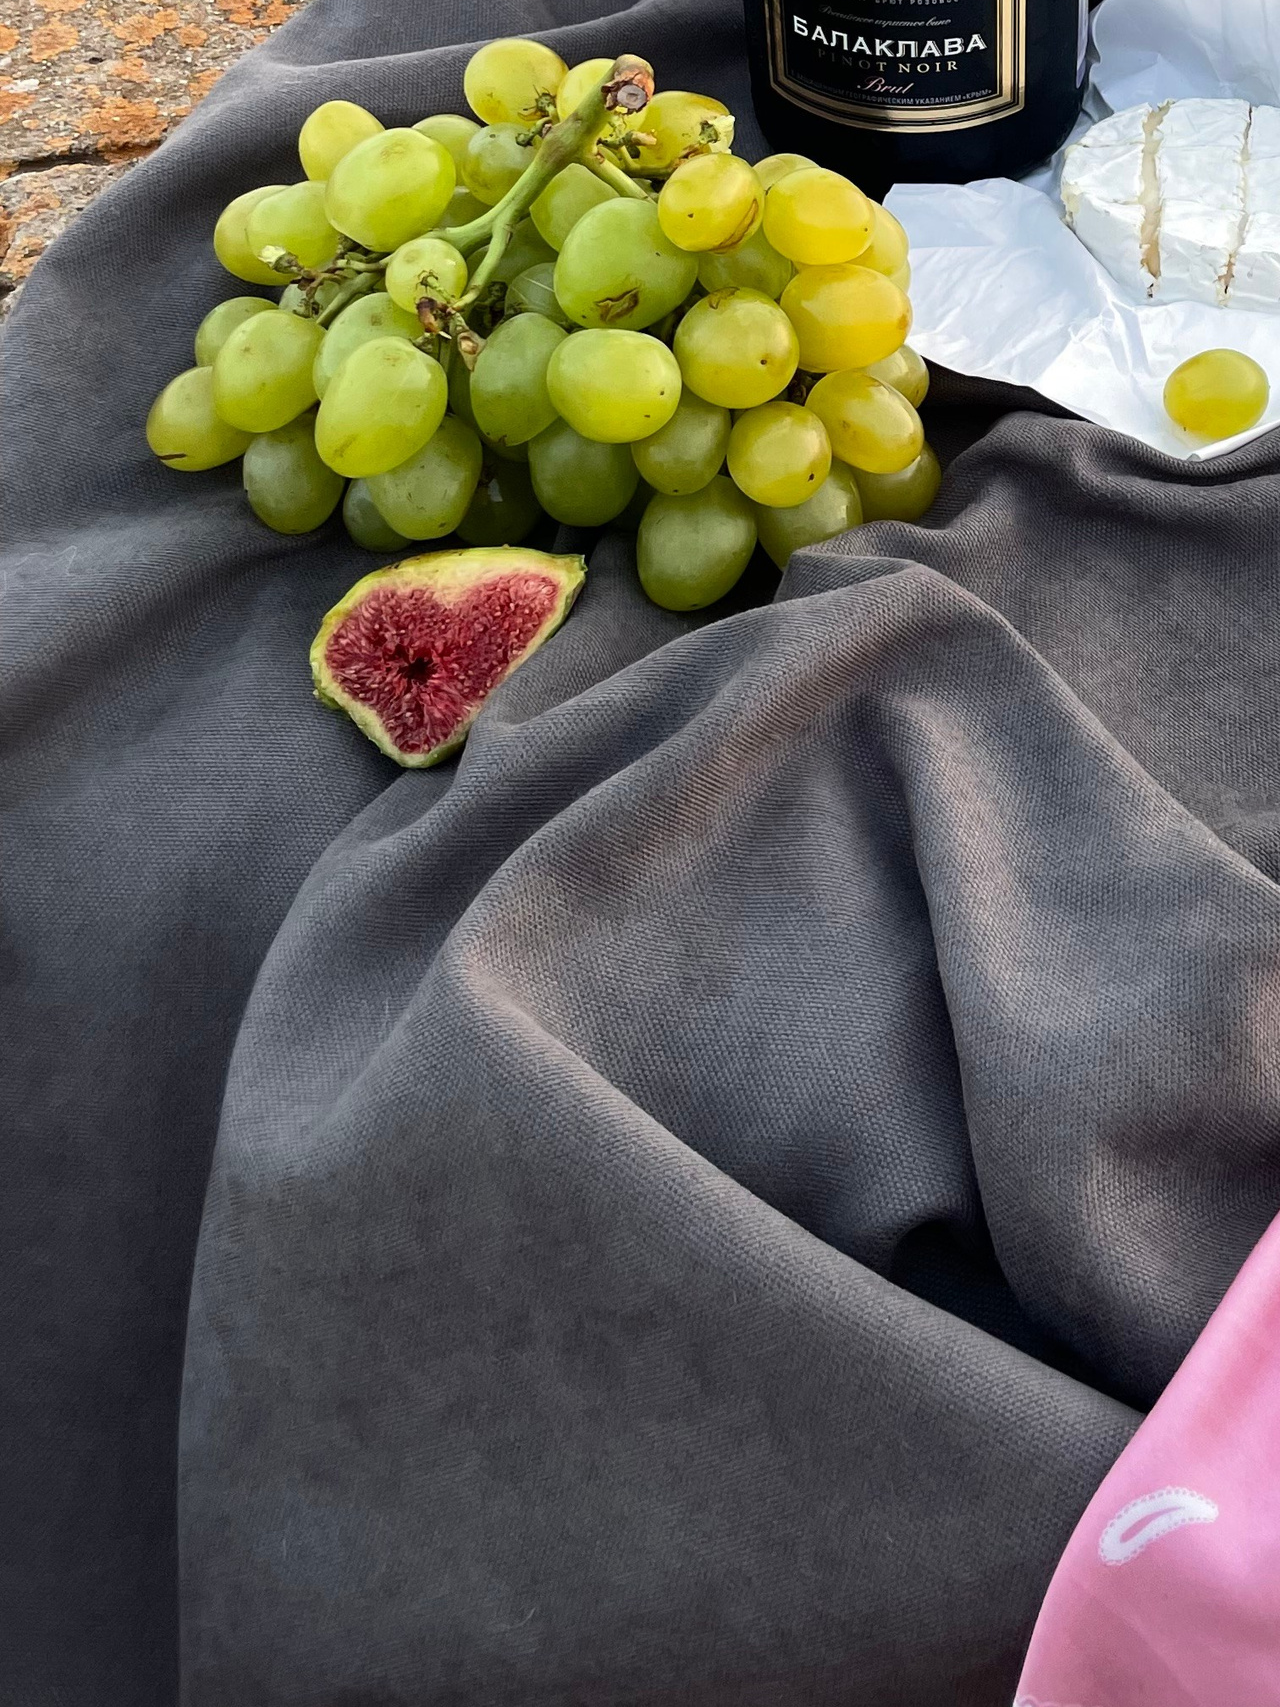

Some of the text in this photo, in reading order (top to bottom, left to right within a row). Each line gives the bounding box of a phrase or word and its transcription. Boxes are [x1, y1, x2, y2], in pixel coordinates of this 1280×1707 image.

[792, 14, 988, 58] БАЛАКЛАВА
[817, 48, 959, 74] PINOT NOIR
[856, 76, 915, 95] Brut
[914, 94, 962, 105] УКАЗАНИЕМ
